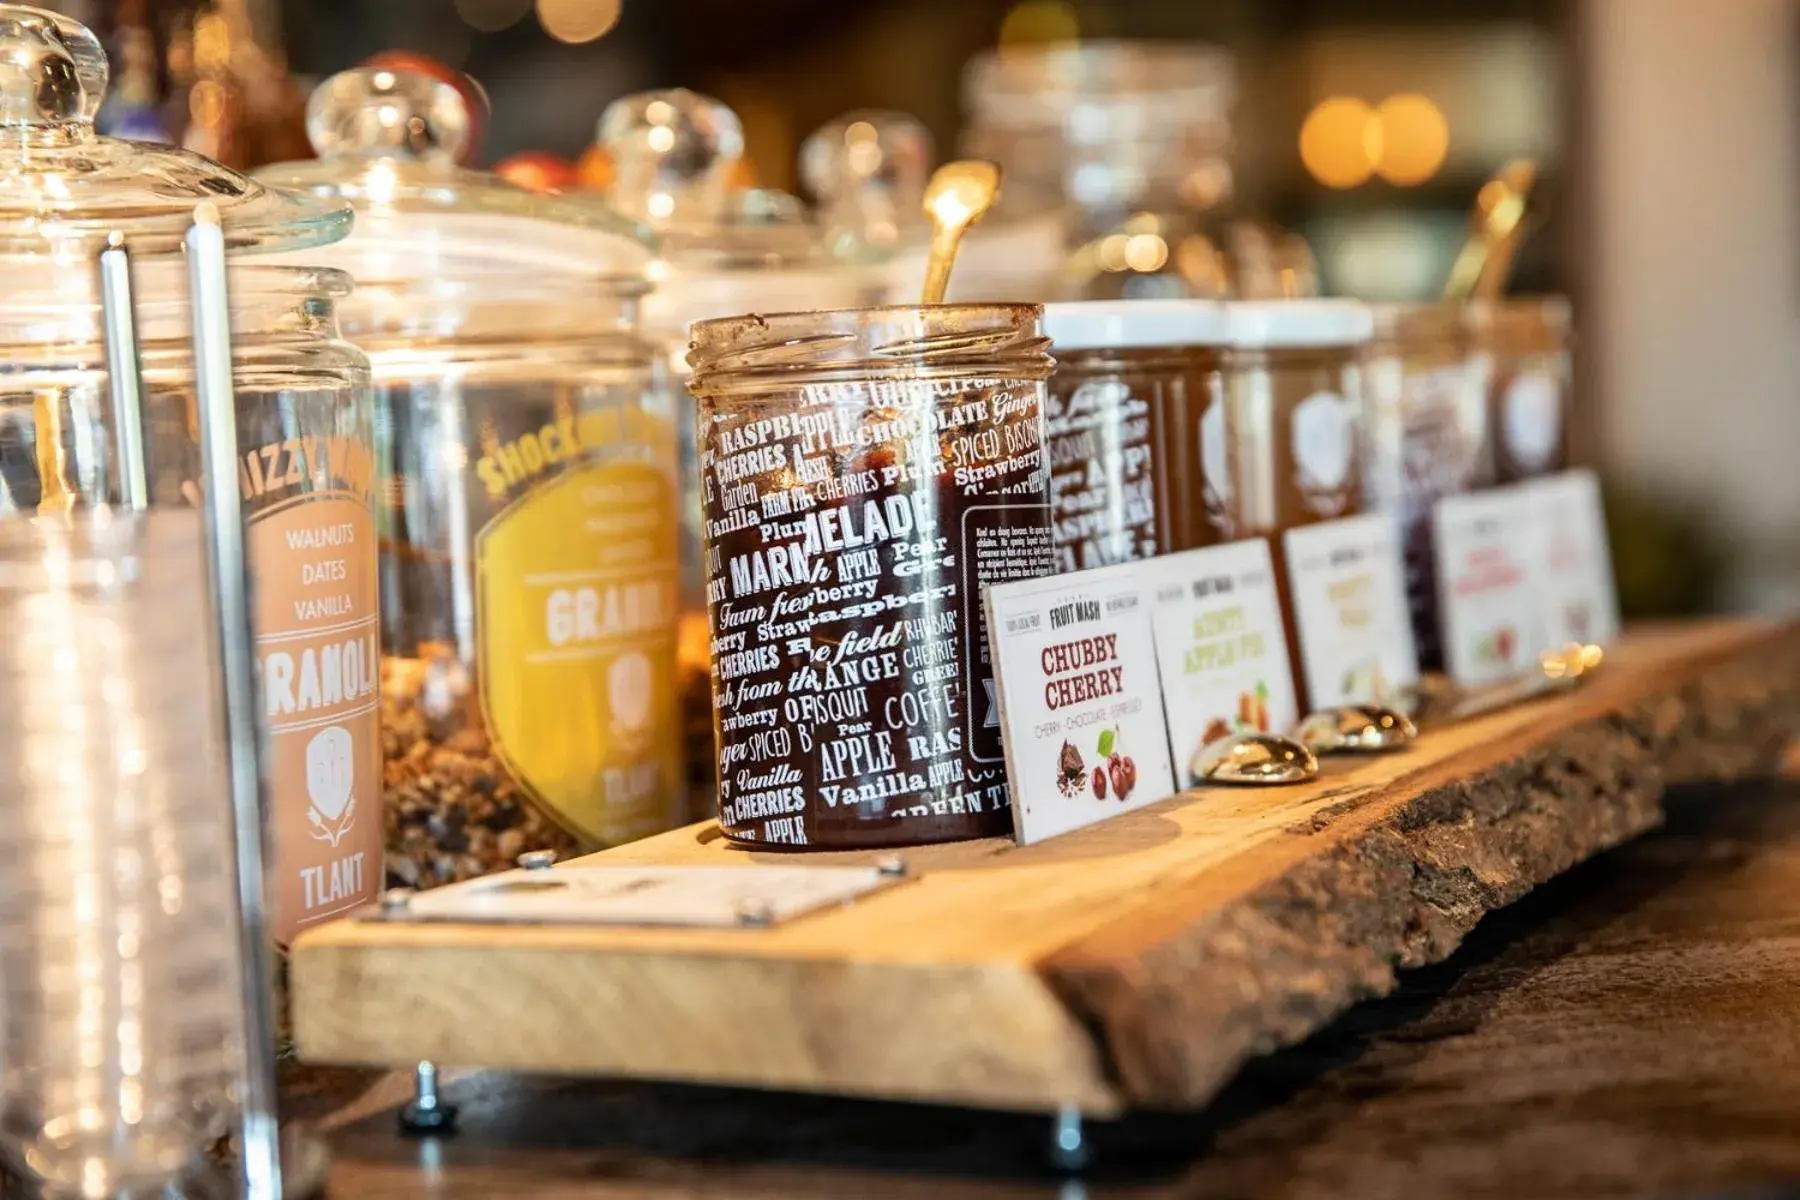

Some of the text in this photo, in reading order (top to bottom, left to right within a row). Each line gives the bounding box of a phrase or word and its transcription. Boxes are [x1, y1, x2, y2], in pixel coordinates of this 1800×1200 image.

[714, 443, 787, 486] CHERRIES
[951, 428, 1001, 467] SPICED
[816, 469, 880, 502] CHERRIES
[953, 449, 1041, 487] Strawberry
[720, 479, 759, 513] Garden
[285, 522, 354, 551] WALNUTS
[706, 506, 761, 541] Vanilla
[836, 547, 881, 584] APPLE
[891, 536, 949, 563] Pear
[301, 558, 347, 586] DATES
[293, 595, 354, 622] VANILLA
[902, 609, 958, 643] RHUBAR
[1049, 602, 1076, 631] FRUIT
[1075, 599, 1102, 623] MASH
[832, 619, 903, 669] field
[902, 635, 958, 670] CHERRIE
[1040, 632, 1119, 677] CHUBBY
[719, 643, 781, 681] CHERRIES
[732, 678, 784, 712] from
[1044, 665, 1124, 711] CHERRY
[884, 681, 961, 732] COFFE
[748, 726, 792, 763] SPICED
[837, 720, 873, 738] Pear
[1034, 719, 1061, 740] CHERRY
[820, 730, 897, 784] APPLE
[736, 763, 803, 792] Vanilla
[817, 771, 928, 809] Vanilla
[927, 757, 965, 788] APPLE
[734, 785, 807, 822] CHERRIES
[764, 814, 809, 845] APPLE
[300, 851, 364, 911] TLANT
